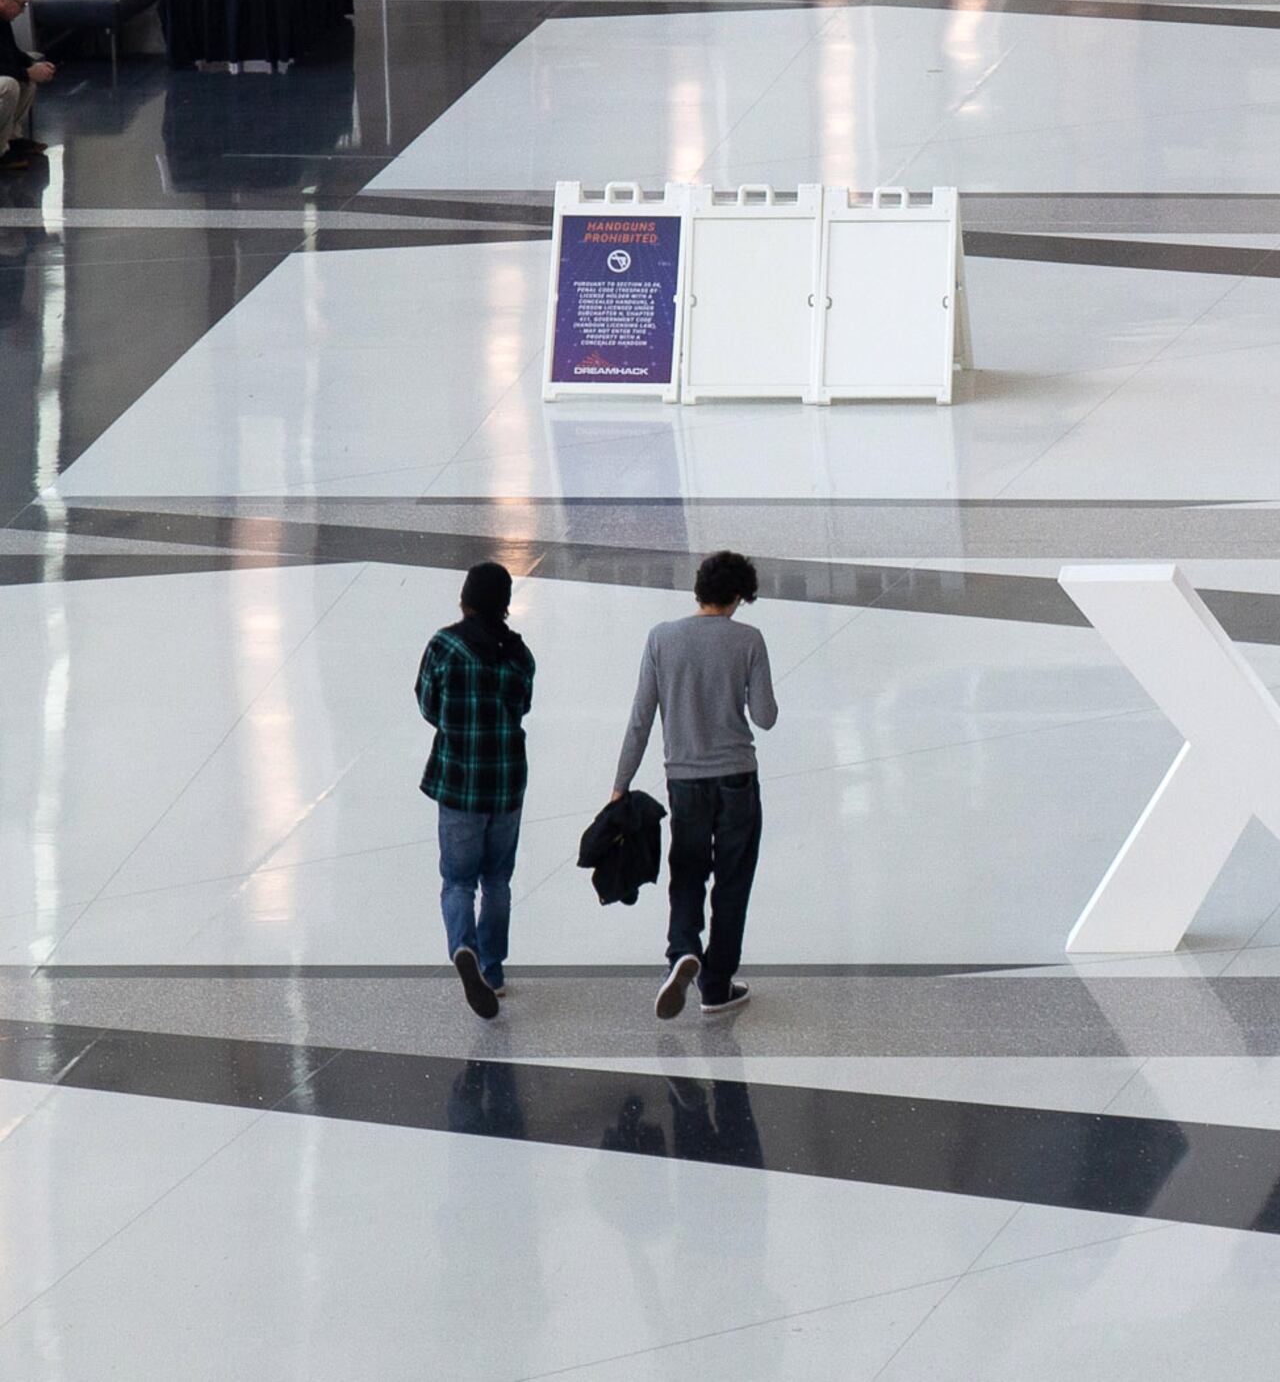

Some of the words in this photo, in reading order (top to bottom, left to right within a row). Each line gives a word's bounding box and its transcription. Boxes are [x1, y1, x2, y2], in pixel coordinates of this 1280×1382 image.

[587, 221, 656, 231] HANDGUNS
[584, 233, 658, 244] PROHIBITED
[573, 366, 649, 375] DREAMHACK
